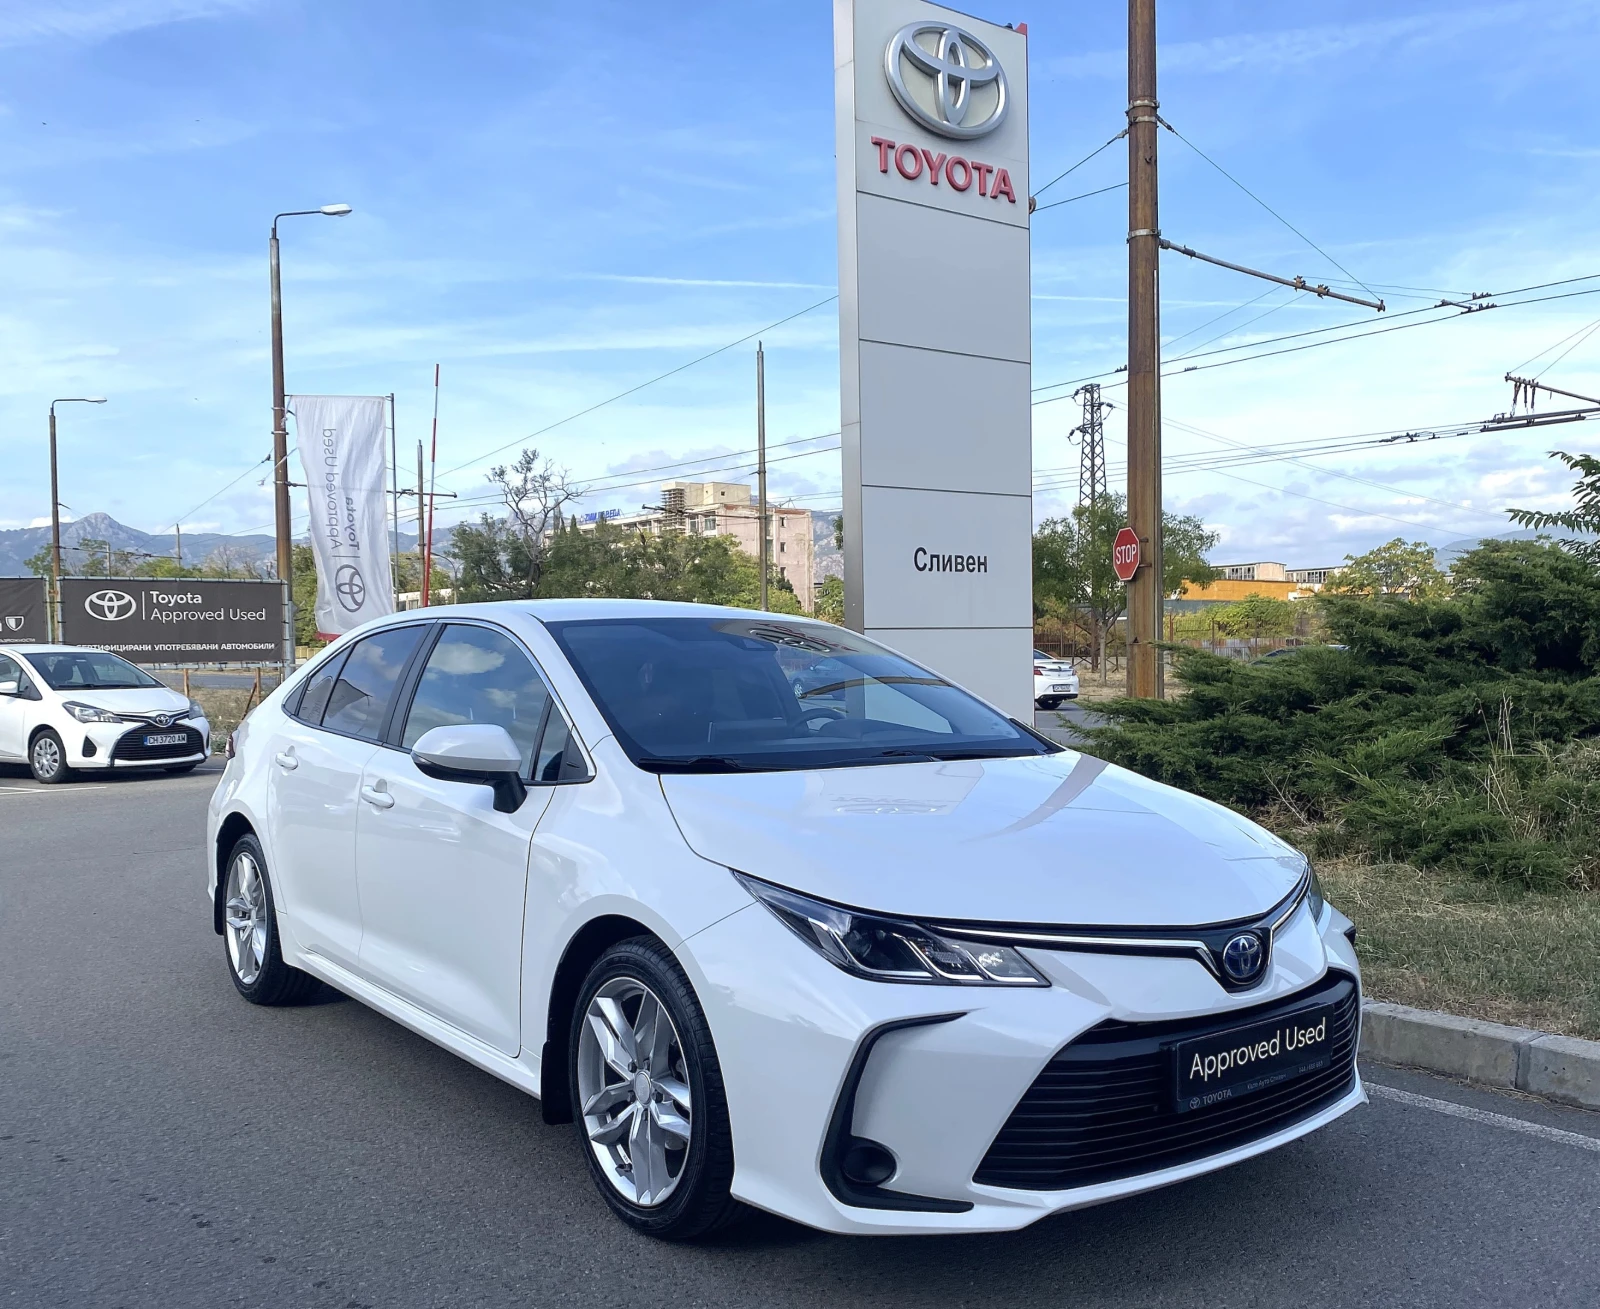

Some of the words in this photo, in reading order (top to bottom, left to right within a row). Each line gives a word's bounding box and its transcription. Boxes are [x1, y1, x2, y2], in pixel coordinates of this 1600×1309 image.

[871, 136, 1016, 203] TOYOTA
[914, 547, 988, 573] Сливен
[1115, 547, 1137, 565] STOP
[150, 591, 202, 605] Toyota
[150, 608, 224, 623] Approved
[229, 608, 266, 621] Used
[154, 643, 218, 651] УПОТРЕБЯВАНИ
[221, 642, 275, 650] АВТОМОБИЛИ
[1189, 1030, 1280, 1081] Approved
[1286, 1016, 1326, 1051] Used
[1202, 1089, 1232, 1105] TOYOTA
